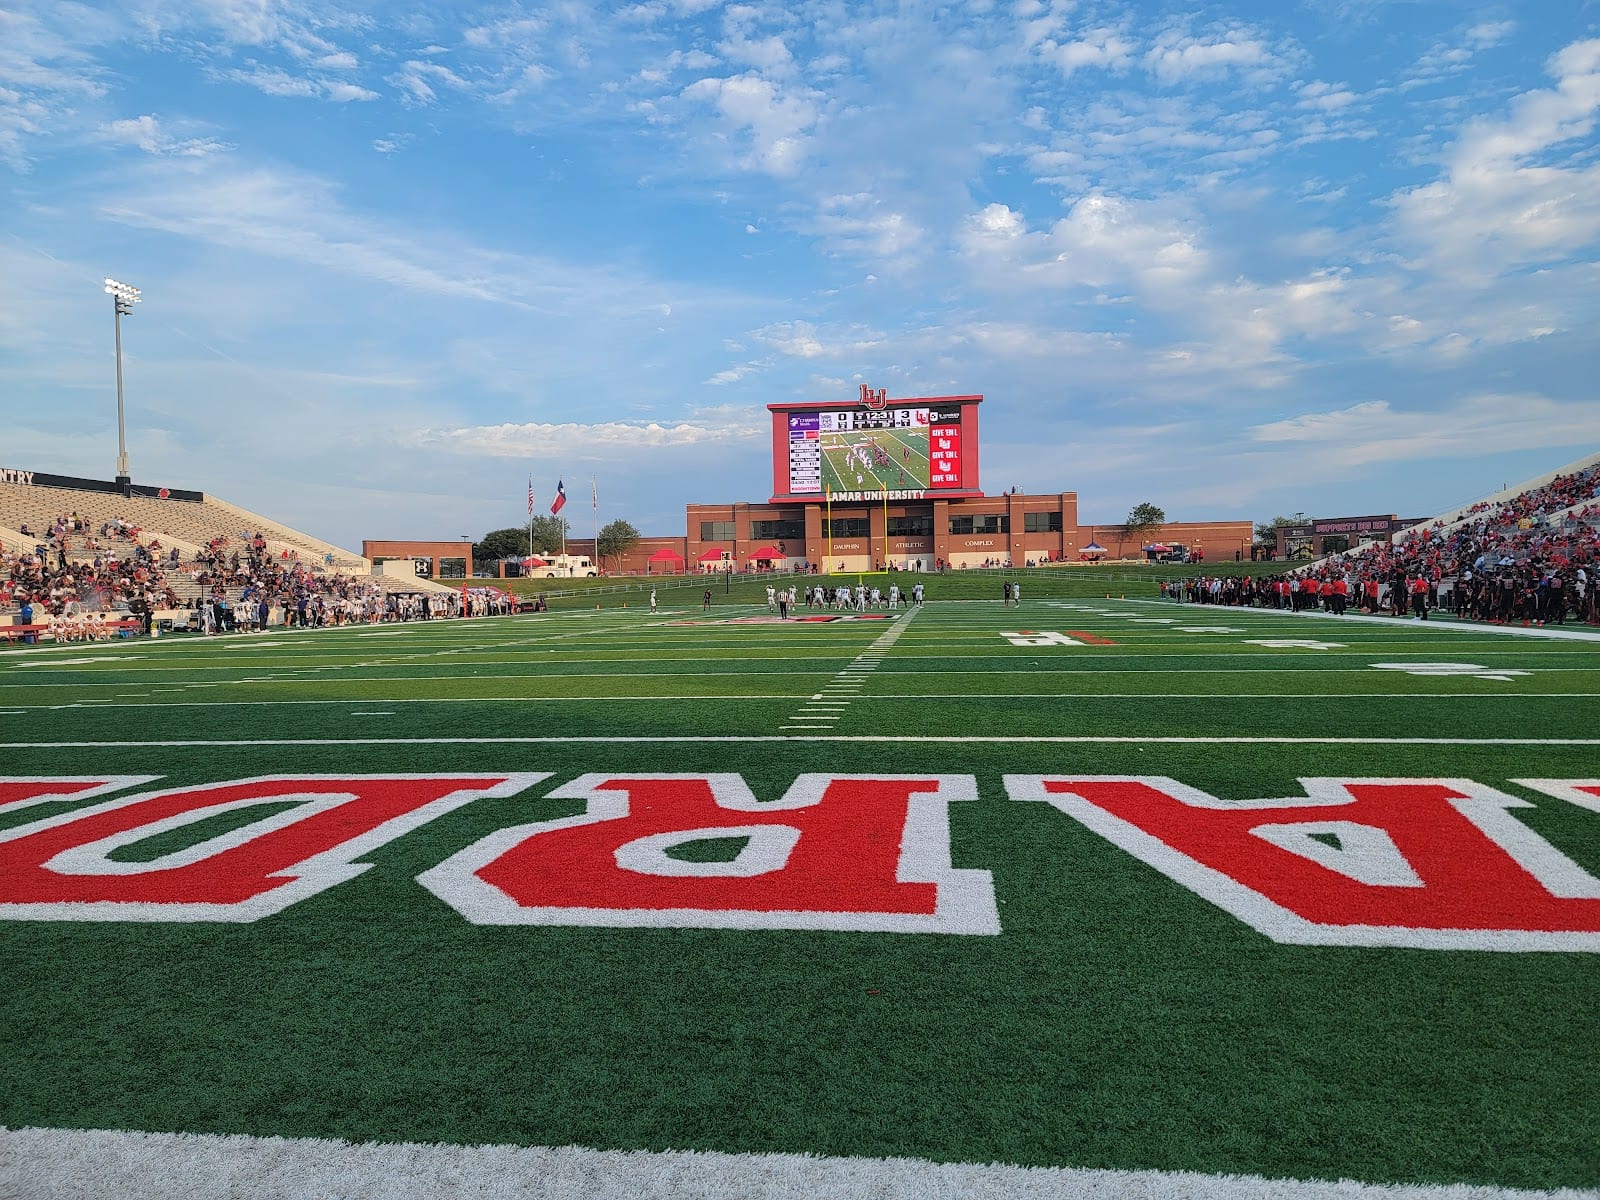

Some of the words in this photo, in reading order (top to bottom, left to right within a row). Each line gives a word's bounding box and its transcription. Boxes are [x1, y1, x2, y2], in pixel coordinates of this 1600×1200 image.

[859, 384, 886, 410] LU
[866, 412, 894, 420] 12:31
[901, 410, 910, 419] 3
[863, 489, 925, 501] UNIVERSITY
